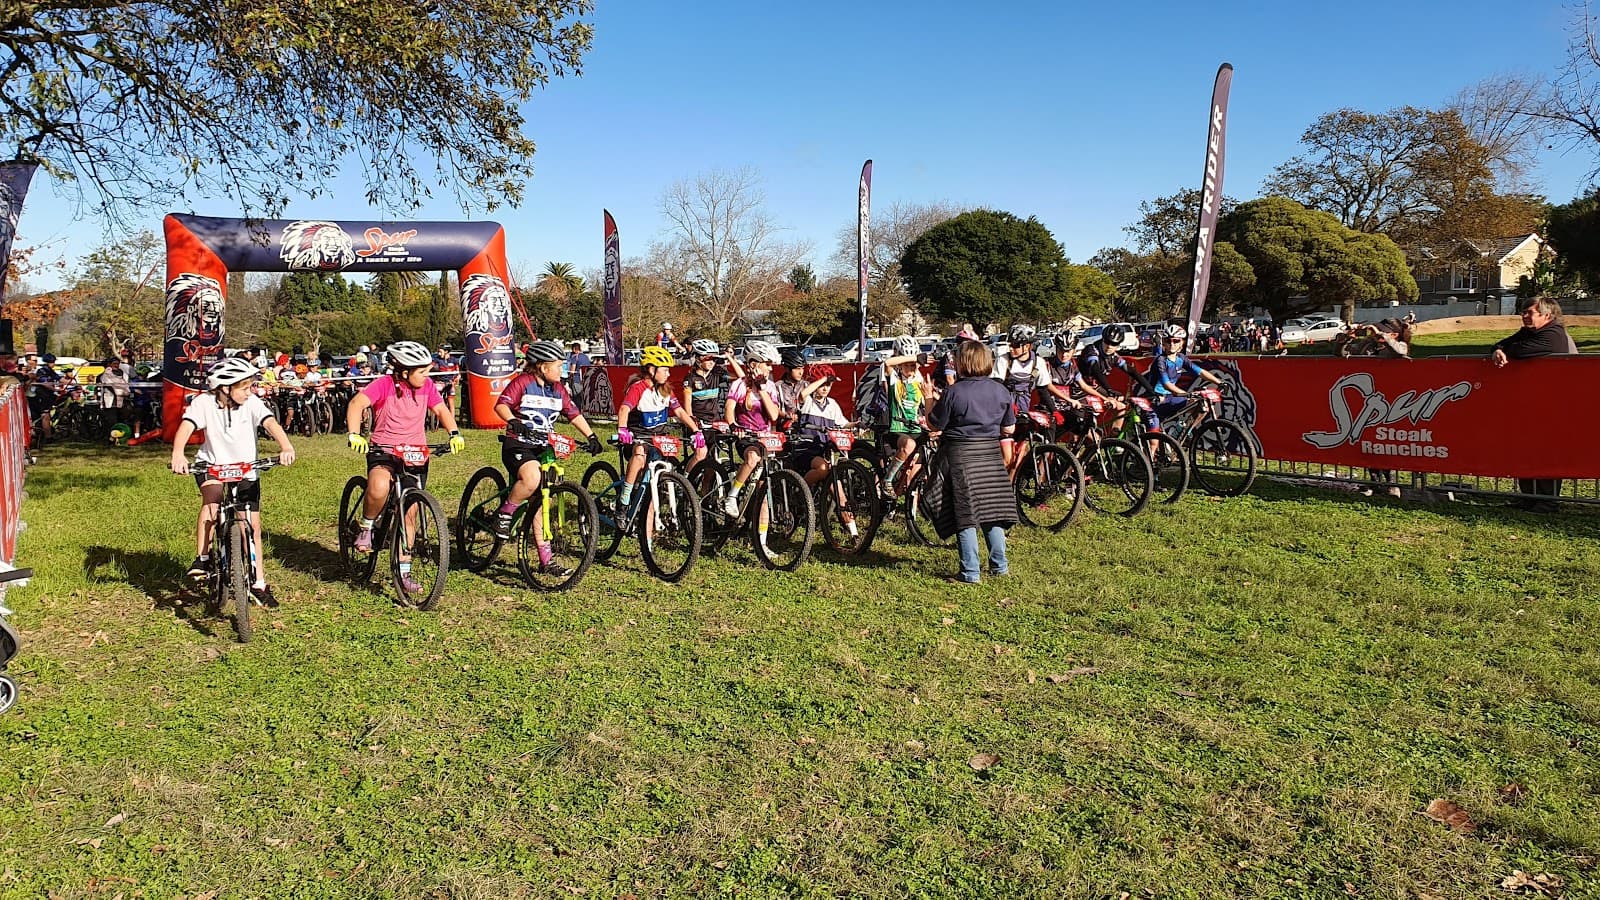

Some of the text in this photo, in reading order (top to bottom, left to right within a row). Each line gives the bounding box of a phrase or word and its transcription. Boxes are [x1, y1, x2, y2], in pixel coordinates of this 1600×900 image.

[1203, 104, 1223, 214] RIDER
[355, 226, 418, 257] Spur
[474, 332, 514, 355] Spur
[1302, 372, 1472, 450] Spur
[1375, 426, 1433, 442] Steak
[1361, 441, 1449, 458] Ranches
